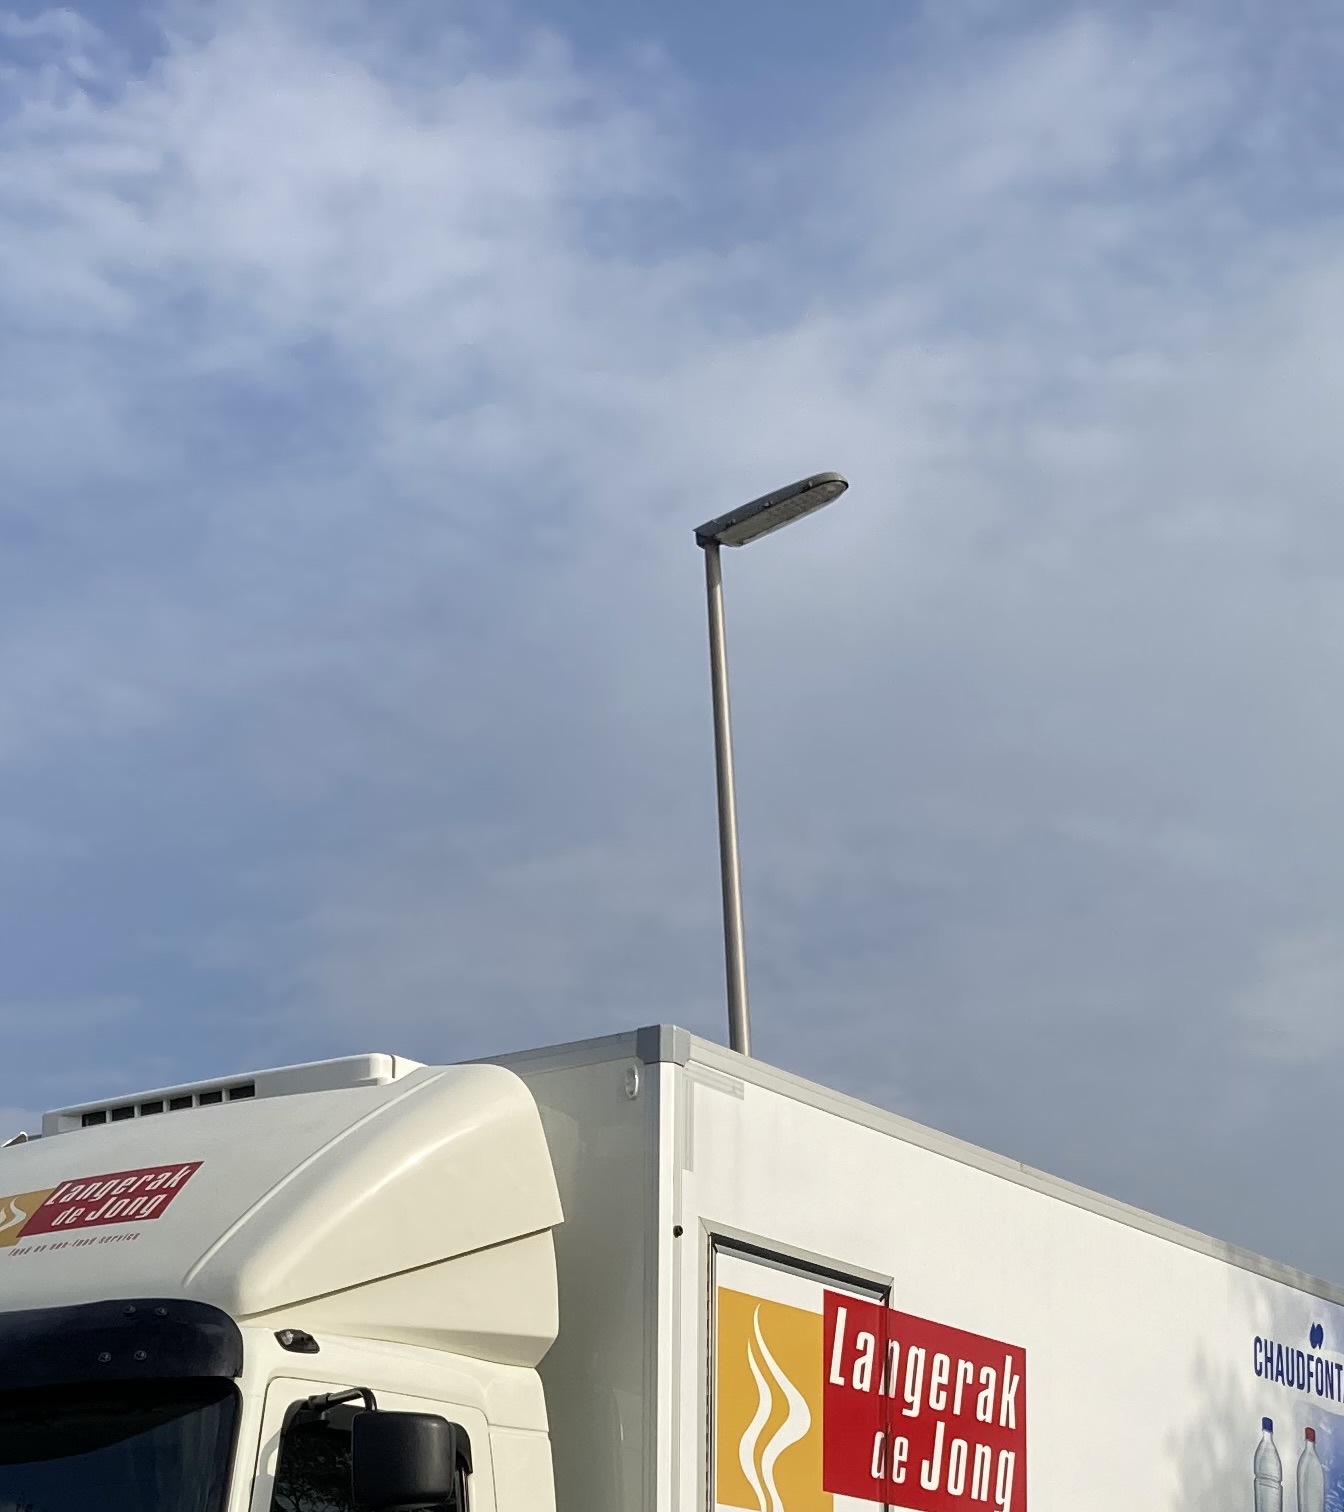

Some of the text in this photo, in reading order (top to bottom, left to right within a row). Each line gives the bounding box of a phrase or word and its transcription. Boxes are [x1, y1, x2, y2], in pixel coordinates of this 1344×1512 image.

[44, 1165, 191, 1206] Langerak
[51, 1193, 169, 1227] de Jong
[829, 1306, 1020, 1430] Langerak
